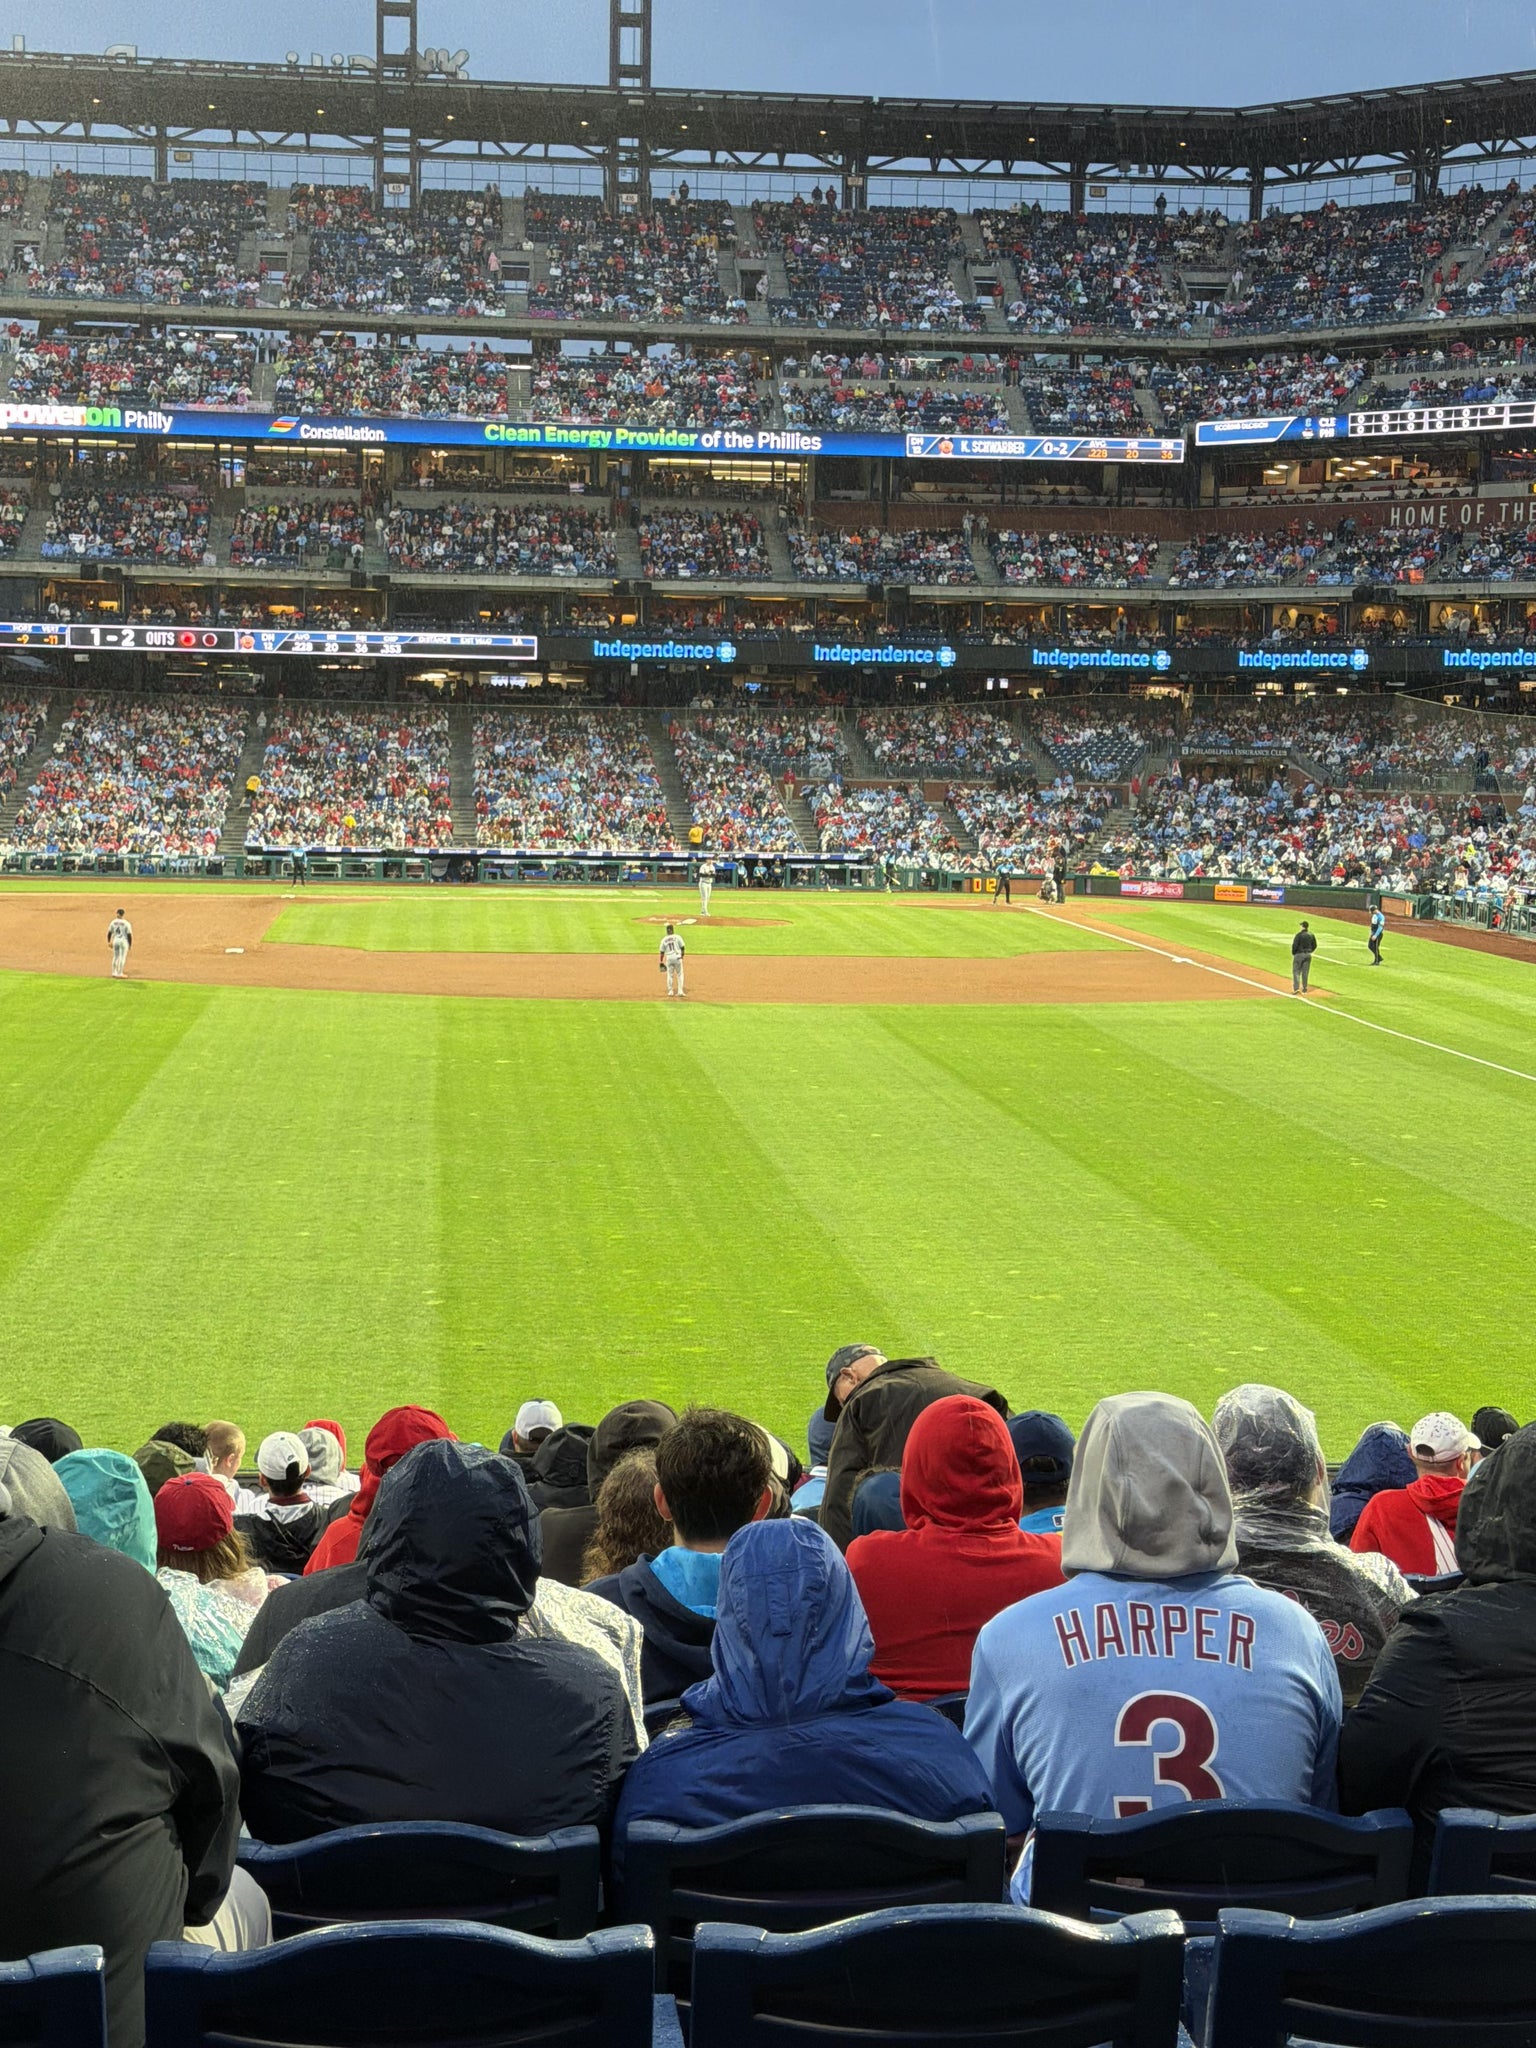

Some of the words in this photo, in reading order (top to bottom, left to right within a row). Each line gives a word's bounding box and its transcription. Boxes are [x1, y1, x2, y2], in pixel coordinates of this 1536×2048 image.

[124, 410, 173, 433] Philly
[1319, 417, 1337, 428] CLE
[1357, 414, 1365, 424] 0
[1382, 413, 1389, 423] 0
[1408, 411, 1415, 421] 0
[1436, 409, 1443, 419] 0
[1463, 408, 1470, 417] 0
[1488, 406, 1495, 416] 0
[484, 424, 541, 441] Clean
[544, 426, 612, 448] Energy
[615, 428, 698, 447] Provider
[701, 429, 723, 447] of
[724, 430, 754, 449] the
[757, 431, 822, 450] Phillies
[1319, 428, 1335, 439] PHI
[1357, 425, 1364, 435] 0
[1382, 423, 1389, 433] 0
[1407, 422, 1415, 432] 0
[1436, 420, 1443, 430] 0
[1462, 419, 1469, 428] 0
[1042, 441, 1068, 455] 0-2
[1088, 449, 1108, 459] .228
[1126, 450, 1139, 459] 20
[1161, 450, 1173, 459] 36
[1390, 505, 1448, 527] HOME
[1460, 503, 1485, 525] OF
[1499, 502, 1536, 523] THE
[16, 634, 30, 645] -9
[43, 635, 59, 645] -11
[146, 631, 175, 646] OUTS
[261, 633, 275, 642] DH
[292, 642, 313, 652] .228
[324, 643, 339, 652] 20
[294, 633, 311, 641] AVG
[594, 640, 714, 661] Independence
[814, 644, 934, 665] Independence
[1033, 649, 1150, 669] Independence
[1239, 650, 1348, 670] Independence
[1444, 648, 1536, 670] Independe
[1190, 746, 1233, 755] PHILADELPHIA
[1234, 748, 1269, 756] INSURANCE
[1052, 1600, 1256, 1671] HARPER
[1114, 1690, 1226, 1818] 3
